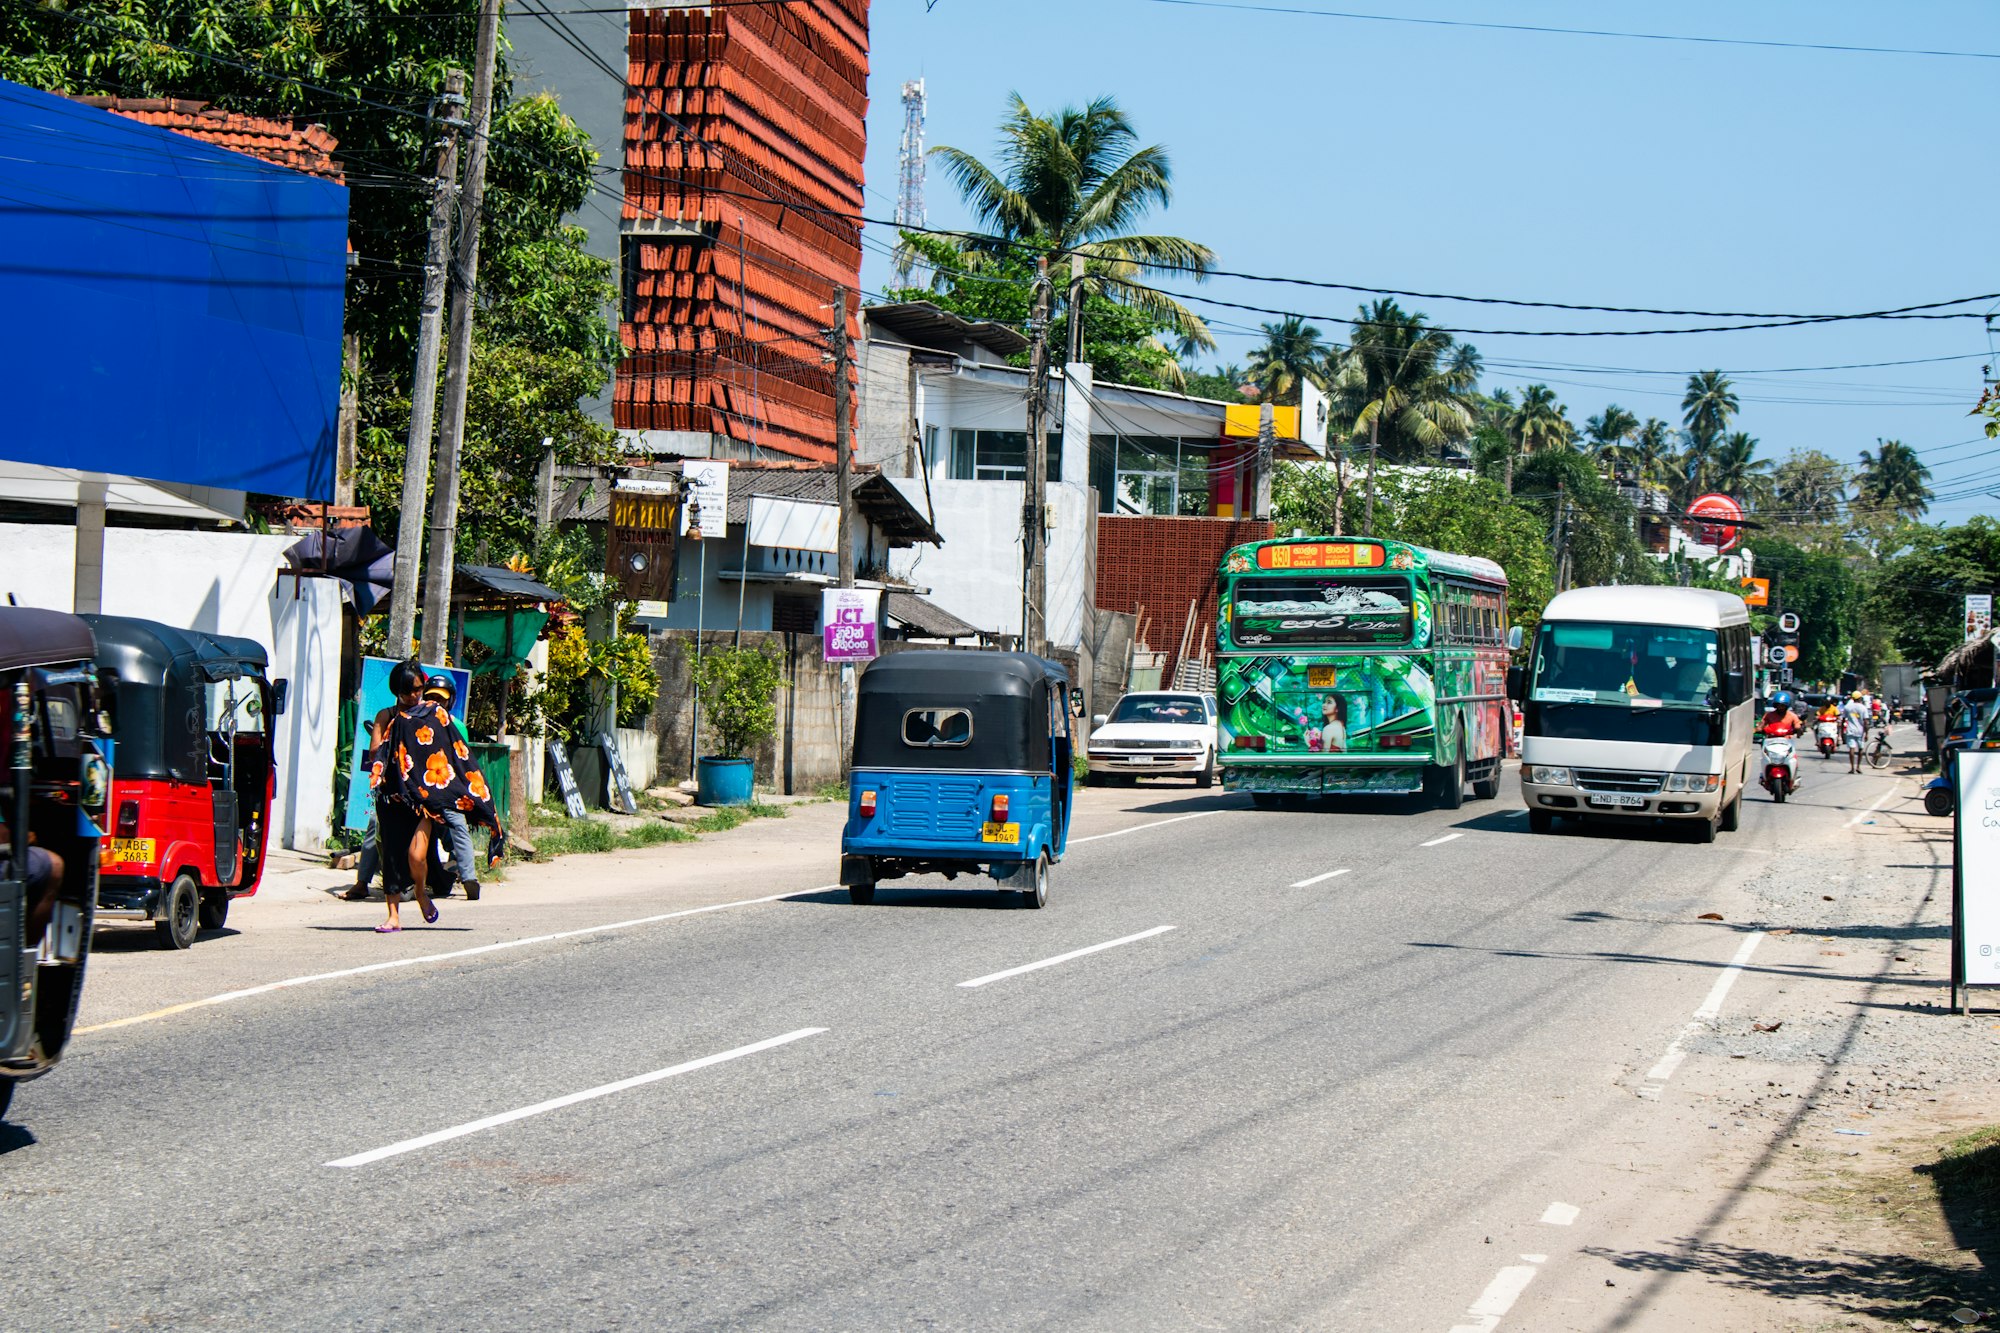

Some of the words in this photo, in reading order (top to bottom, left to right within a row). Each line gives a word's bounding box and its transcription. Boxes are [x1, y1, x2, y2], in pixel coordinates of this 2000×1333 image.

[614, 498, 637, 528] BIG
[640, 499, 677, 529] BELLY
[1273, 547, 1289, 566] 350
[836, 608, 864, 623] ICT
[1312, 677, 1332, 686] 0275
[994, 833, 1015, 842] 1949
[126, 839, 148, 851] ABE
[123, 851, 148, 862] 3683
